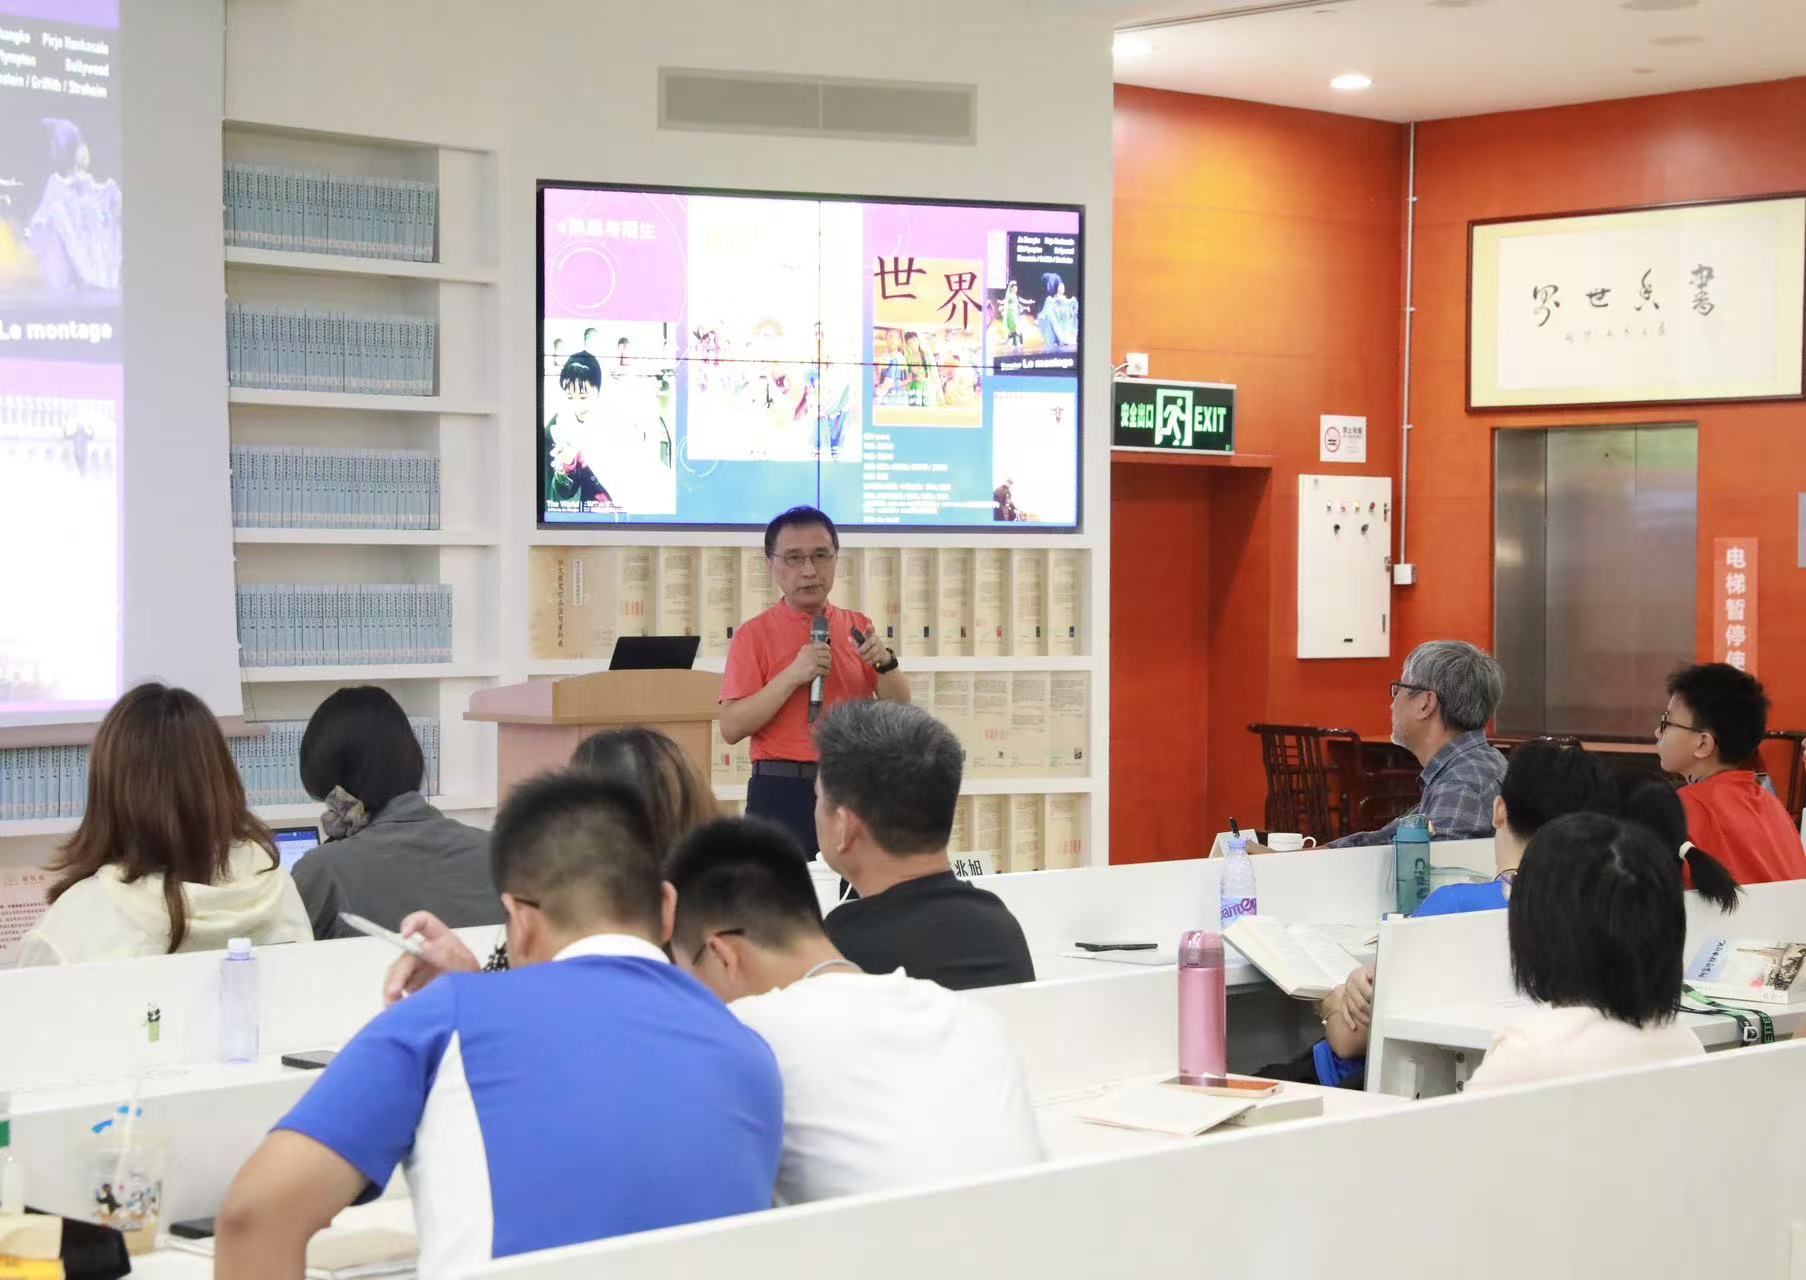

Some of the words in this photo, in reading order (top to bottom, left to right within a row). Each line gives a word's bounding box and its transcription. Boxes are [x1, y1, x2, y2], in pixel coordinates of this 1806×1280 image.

[65, 57, 110, 77] Bollywood
[874, 256, 983, 330] 世界
[0, 320, 22, 340] Le
[26, 320, 113, 344] montage
[1120, 402, 1154, 428] 安全出口
[1194, 406, 1227, 433] EXIT
